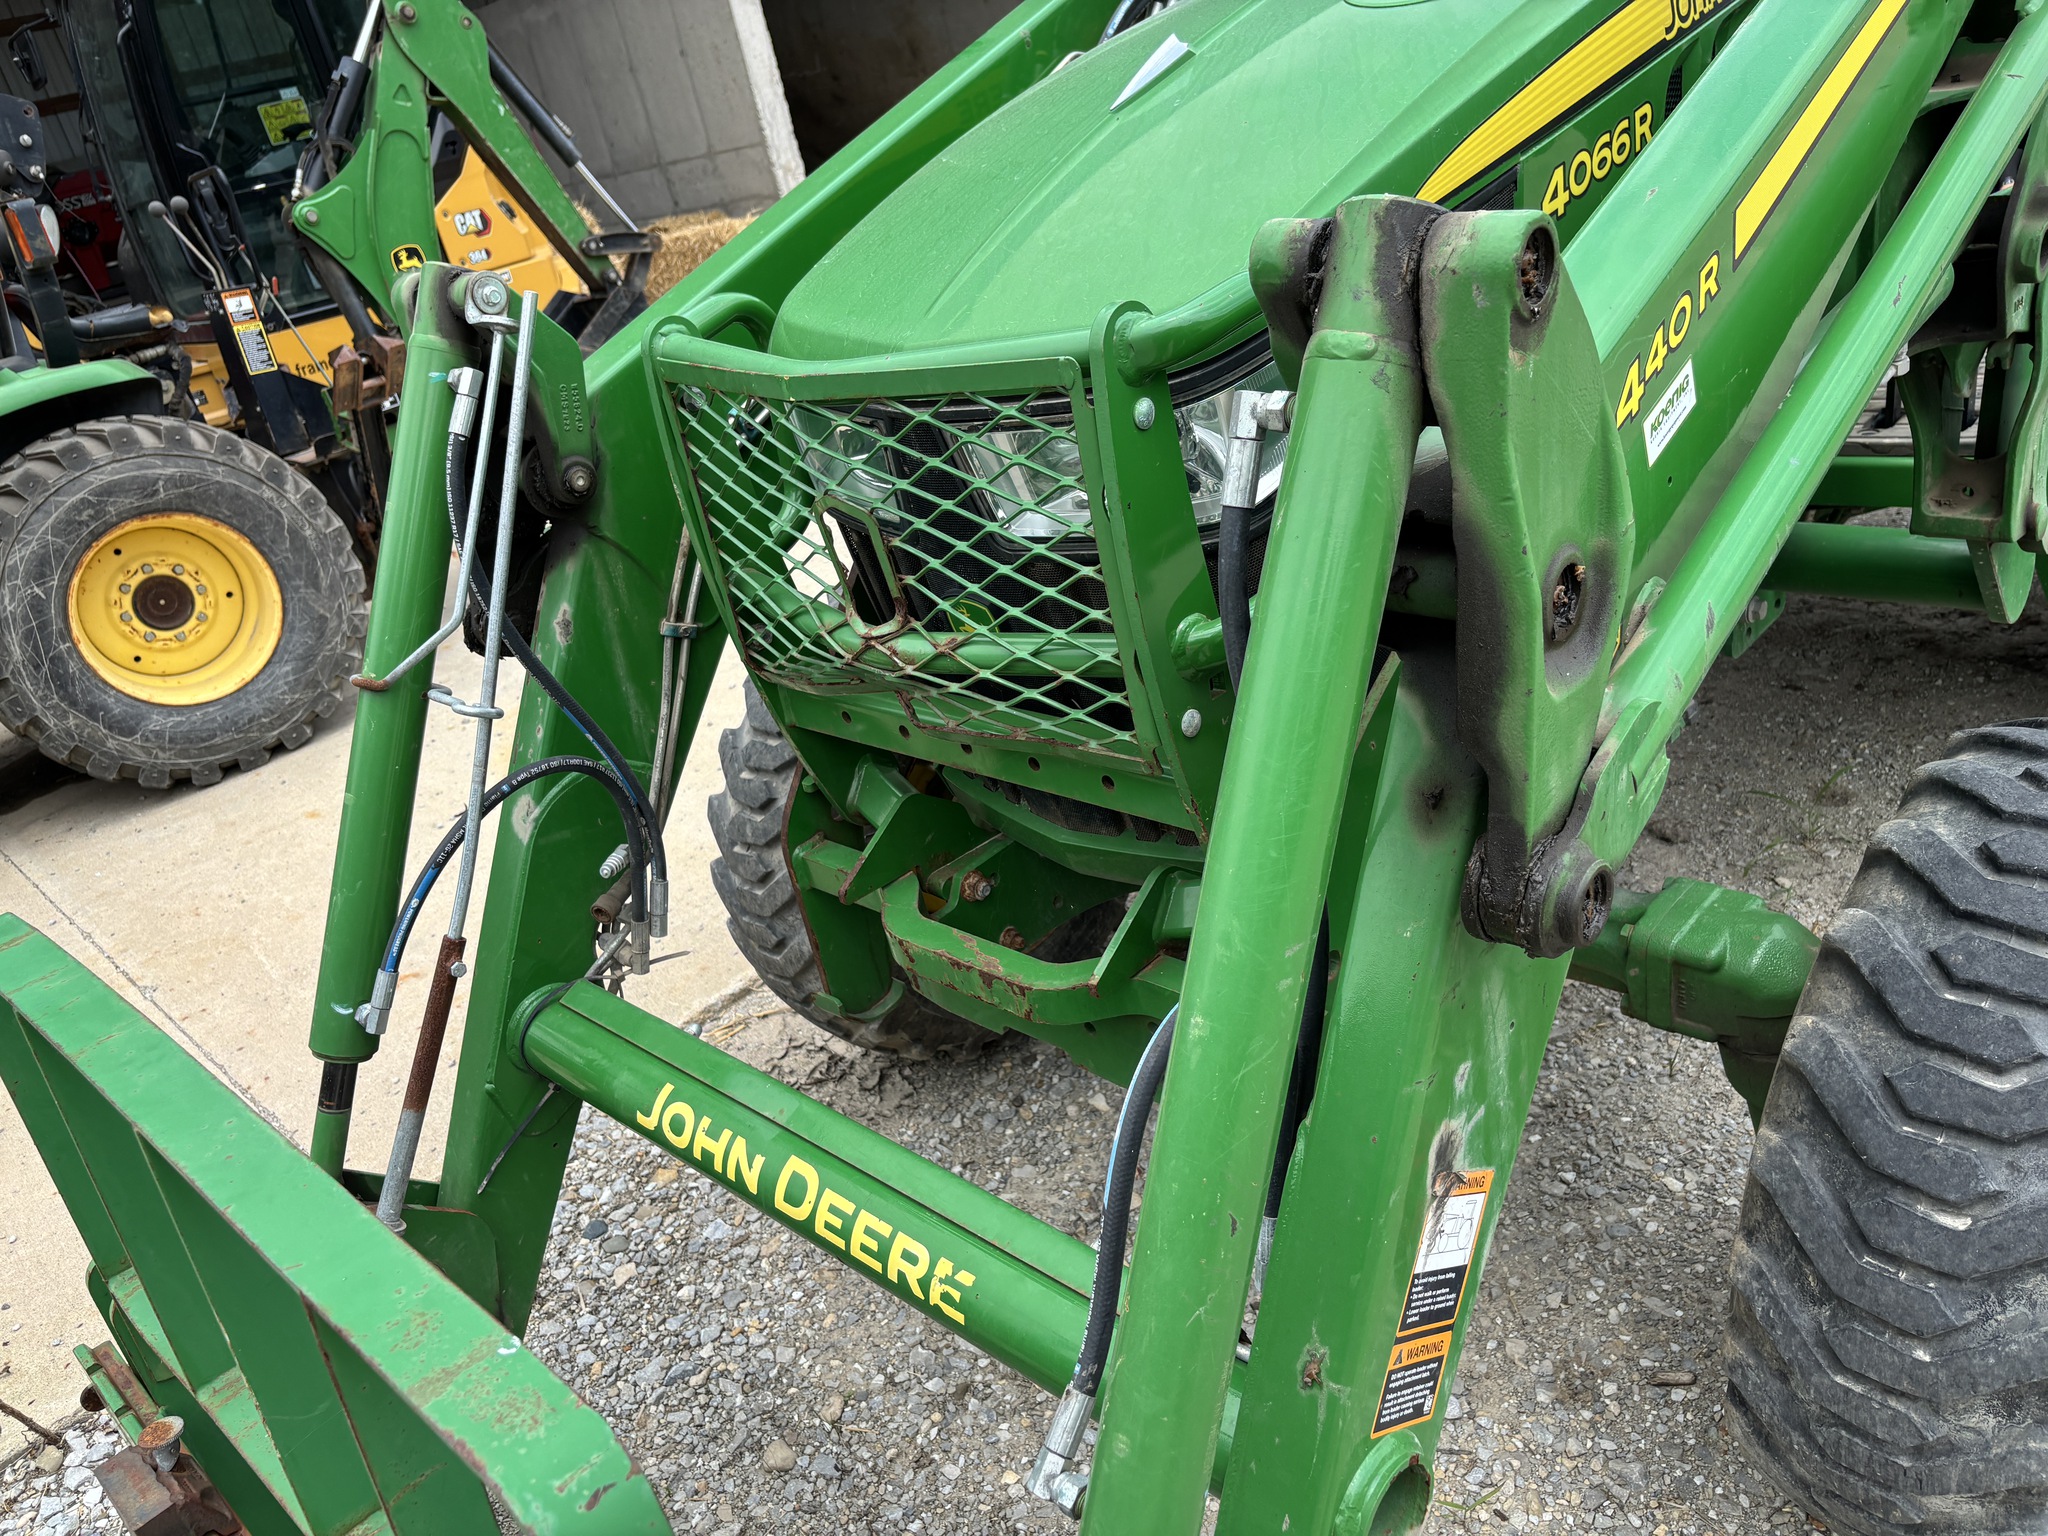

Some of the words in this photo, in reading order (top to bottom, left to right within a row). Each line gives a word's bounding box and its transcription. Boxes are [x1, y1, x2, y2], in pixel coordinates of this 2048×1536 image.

[1664, 0, 1722, 41] JO
[454, 208, 484, 236] CAT
[531, 763, 550, 776] 18752
[550, 761, 560, 769] ISO
[517, 772, 531, 782] Type
[636, 1082, 766, 1195] JOHN
[774, 1154, 977, 1326] DEERE
[1406, 1340, 1444, 1361] WARNING
